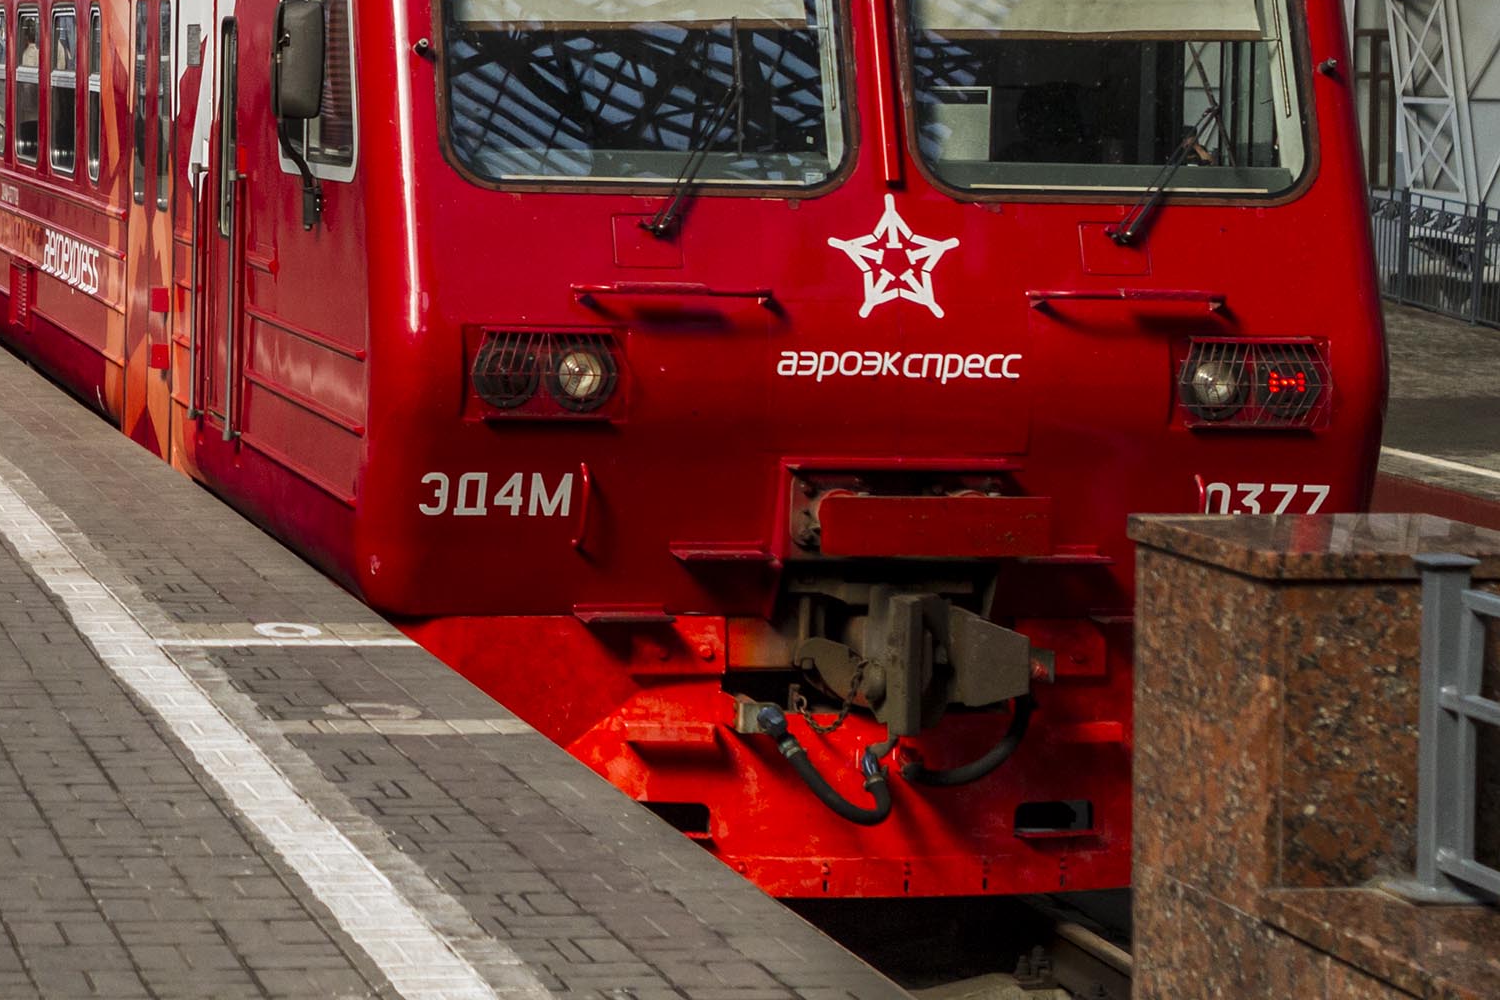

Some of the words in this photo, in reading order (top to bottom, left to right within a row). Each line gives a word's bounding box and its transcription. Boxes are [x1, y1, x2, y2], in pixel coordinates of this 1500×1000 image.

[41, 228, 99, 295] aeroexpress
[777, 351, 1023, 385] аэроэкспресс
[418, 472, 574, 517] ЭД4М
[1205, 482, 1331, 515] 0377
